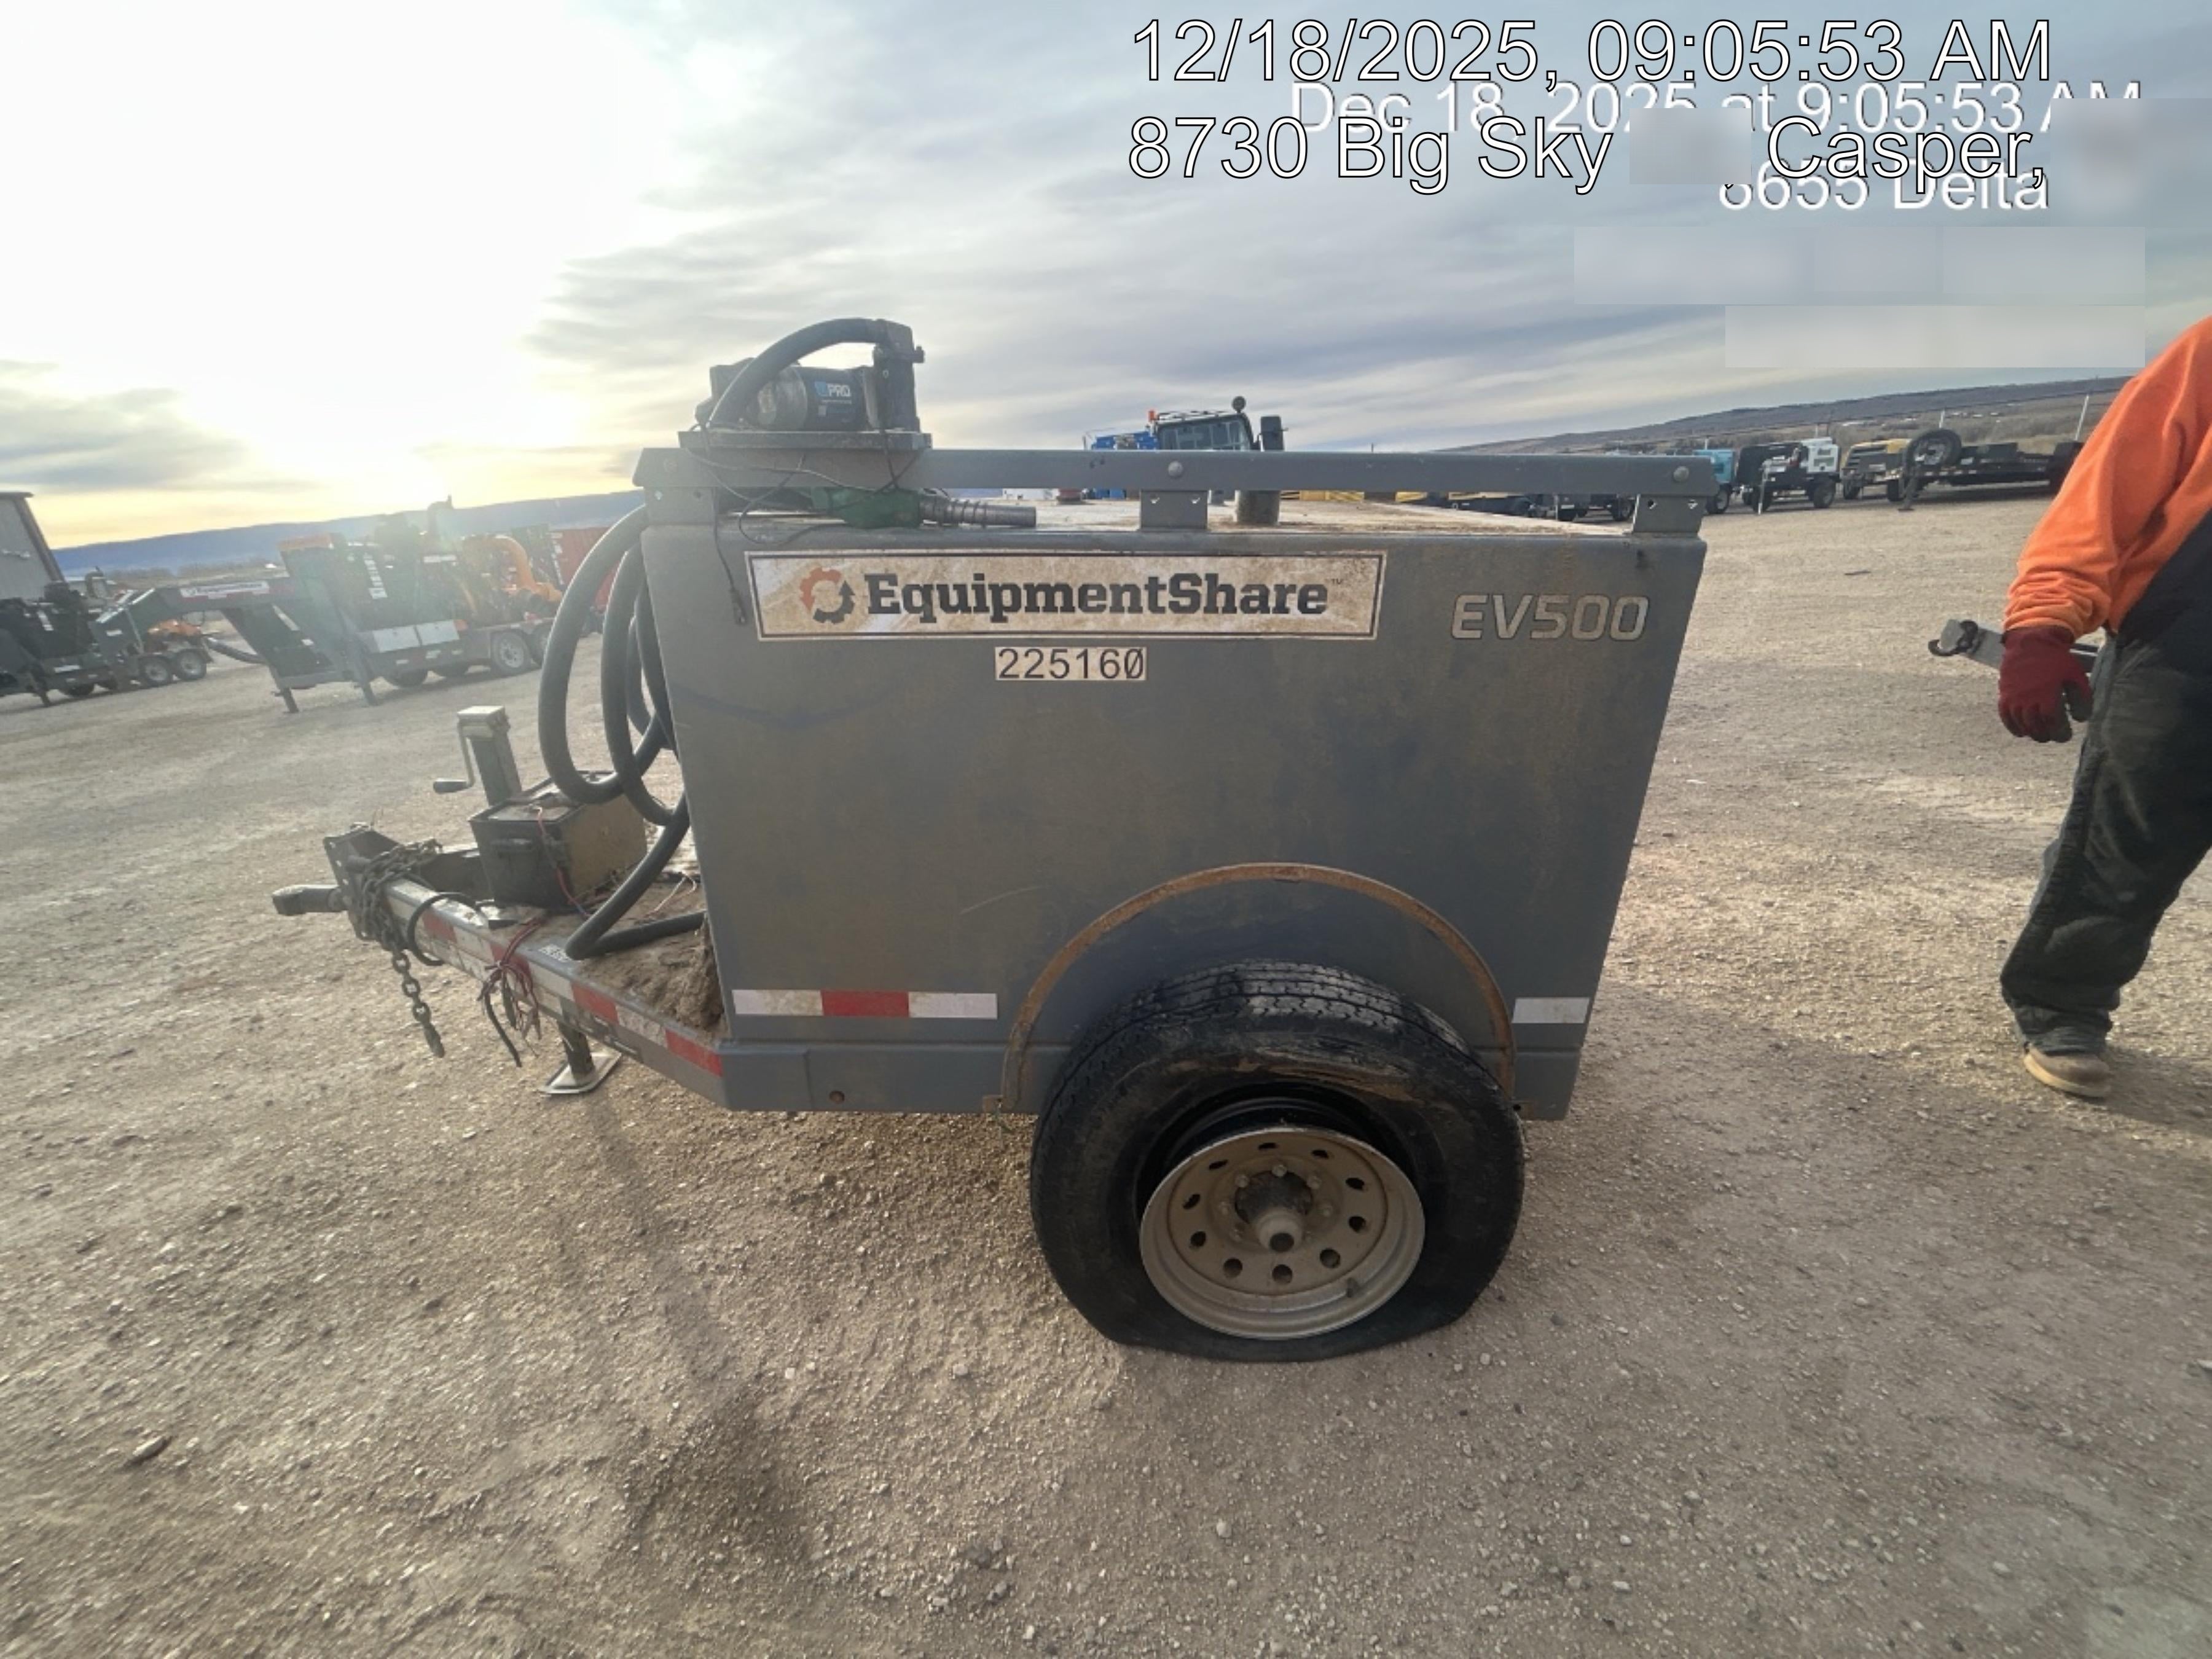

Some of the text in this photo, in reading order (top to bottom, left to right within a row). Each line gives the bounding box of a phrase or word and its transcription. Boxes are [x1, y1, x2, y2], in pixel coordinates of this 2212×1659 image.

[864, 573, 1328, 623] EquipmentShare
[1451, 594, 1649, 641] EV500
[998, 648, 1144, 679] 225160
